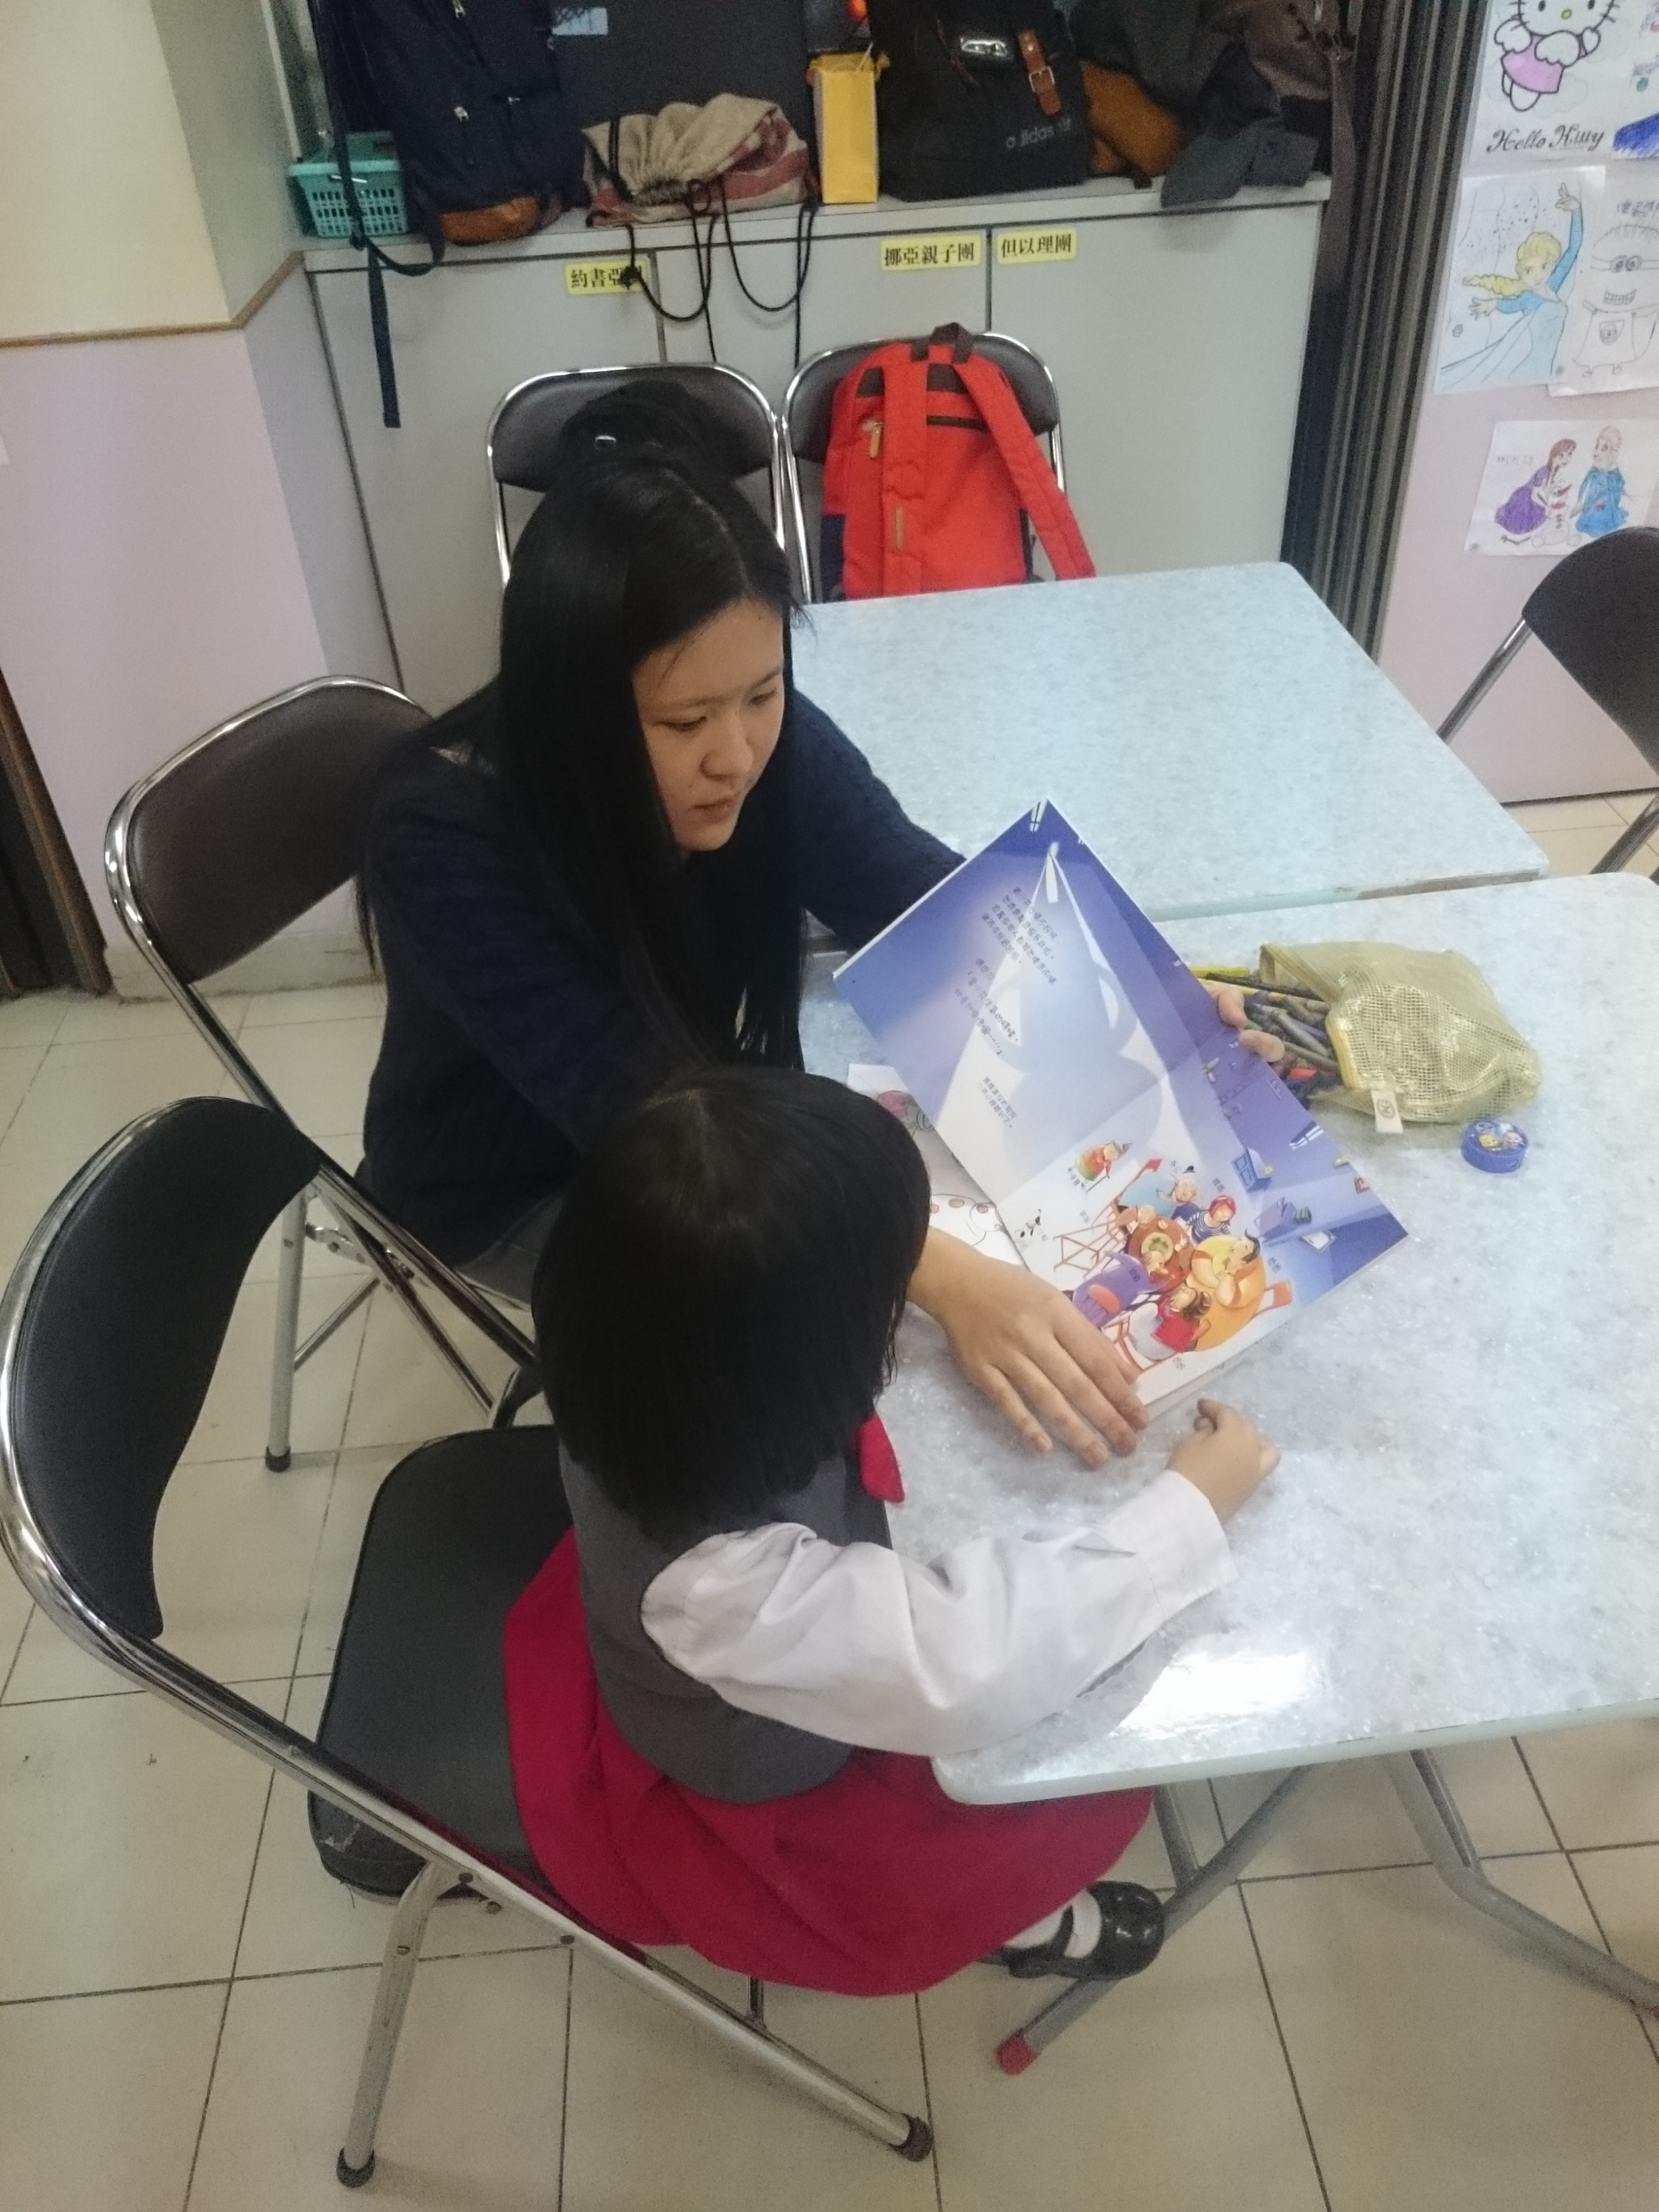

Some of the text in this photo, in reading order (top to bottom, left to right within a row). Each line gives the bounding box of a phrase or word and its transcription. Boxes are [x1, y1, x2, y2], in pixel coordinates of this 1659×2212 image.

[1006, 125, 1054, 149] aidas
[1486, 123, 1605, 152] Hello Kitty
[884, 242, 975, 266] 挪亞親子團
[1002, 233, 1072, 258] 但以理團
[571, 266, 641, 288] 約書亞
